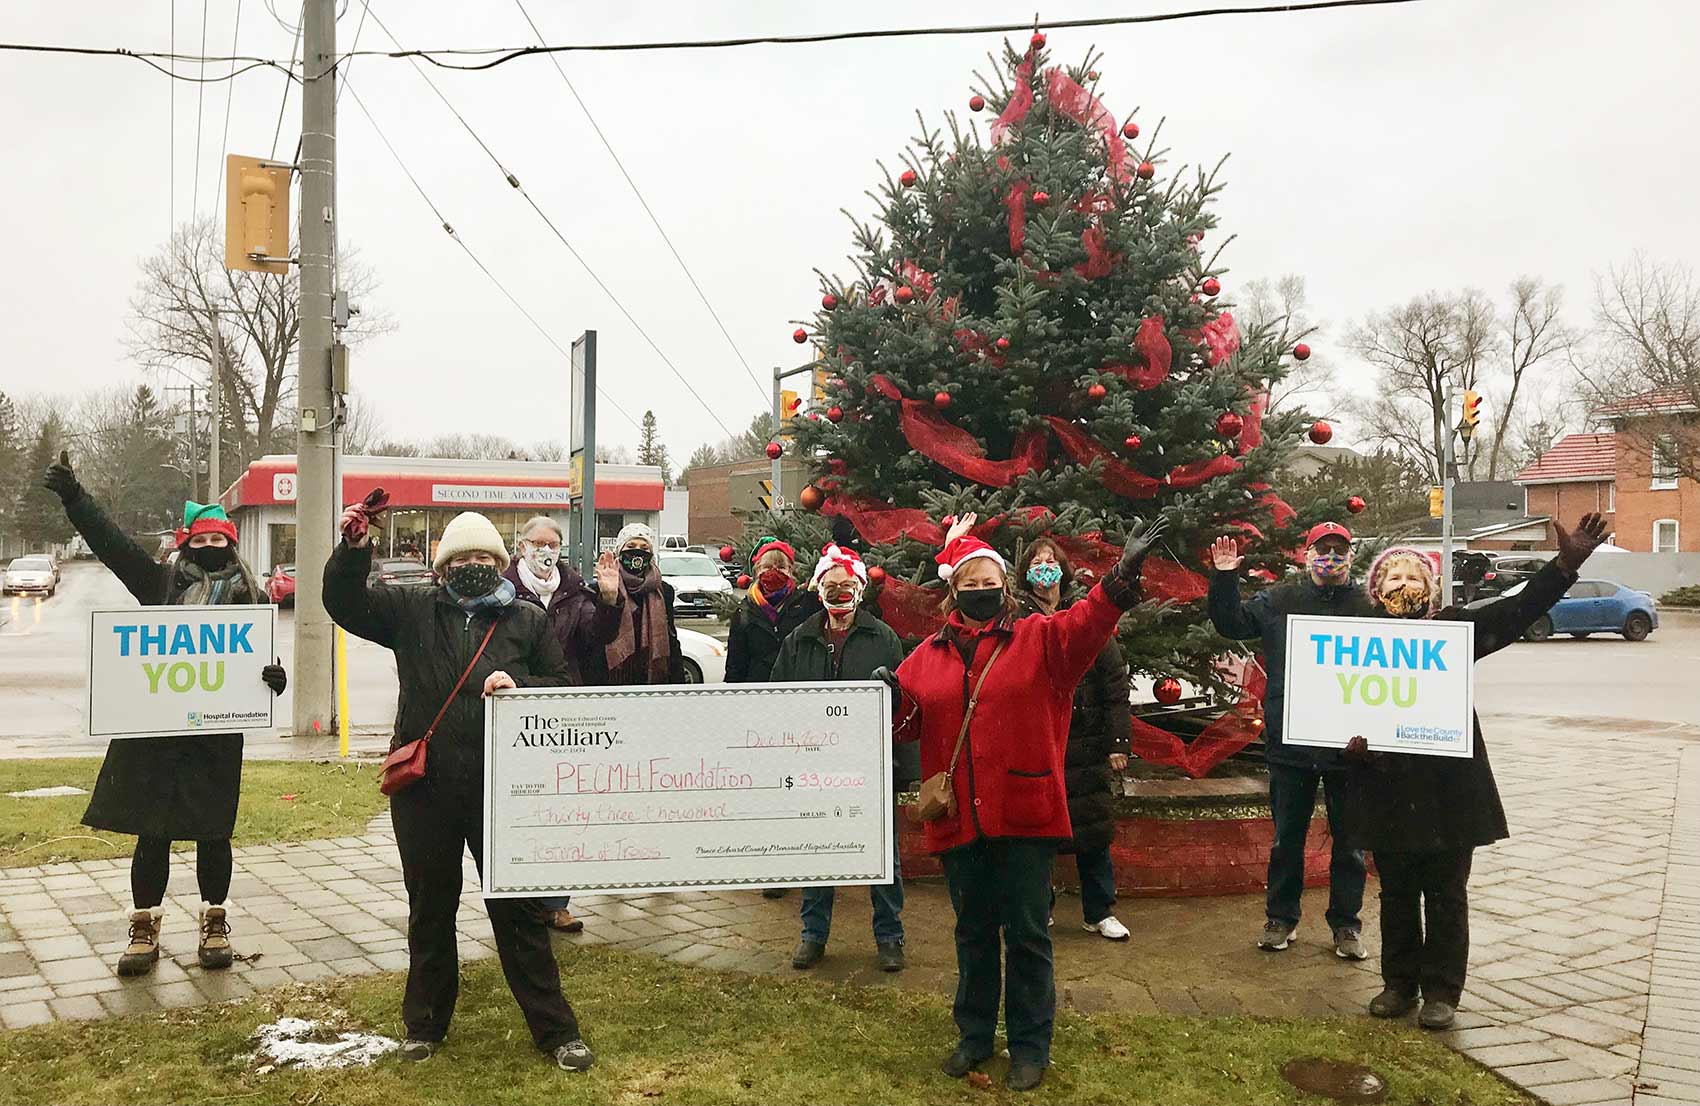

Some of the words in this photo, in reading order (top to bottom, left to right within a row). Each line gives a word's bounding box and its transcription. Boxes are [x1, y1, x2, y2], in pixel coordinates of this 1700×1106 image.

[437, 489, 479, 498] SECOND
[484, 490, 505, 499] TIME
[511, 491, 552, 500] AROUND
[113, 623, 254, 657] THANK
[1310, 634, 1448, 671] THANK
[142, 661, 225, 694] YOU
[1336, 672, 1418, 708] YOU
[203, 712, 231, 720] Hospital
[231, 711, 268, 719] Foundation
[825, 705, 849, 717] 001
[520, 714, 559, 730] The
[1400, 724, 1419, 733] Love
[1433, 727, 1463, 737] County
[1400, 731, 1419, 739] Back
[512, 728, 618, 750] Auxiliary
[650, 757, 753, 792] Foundation
[784, 775, 794, 791] $
